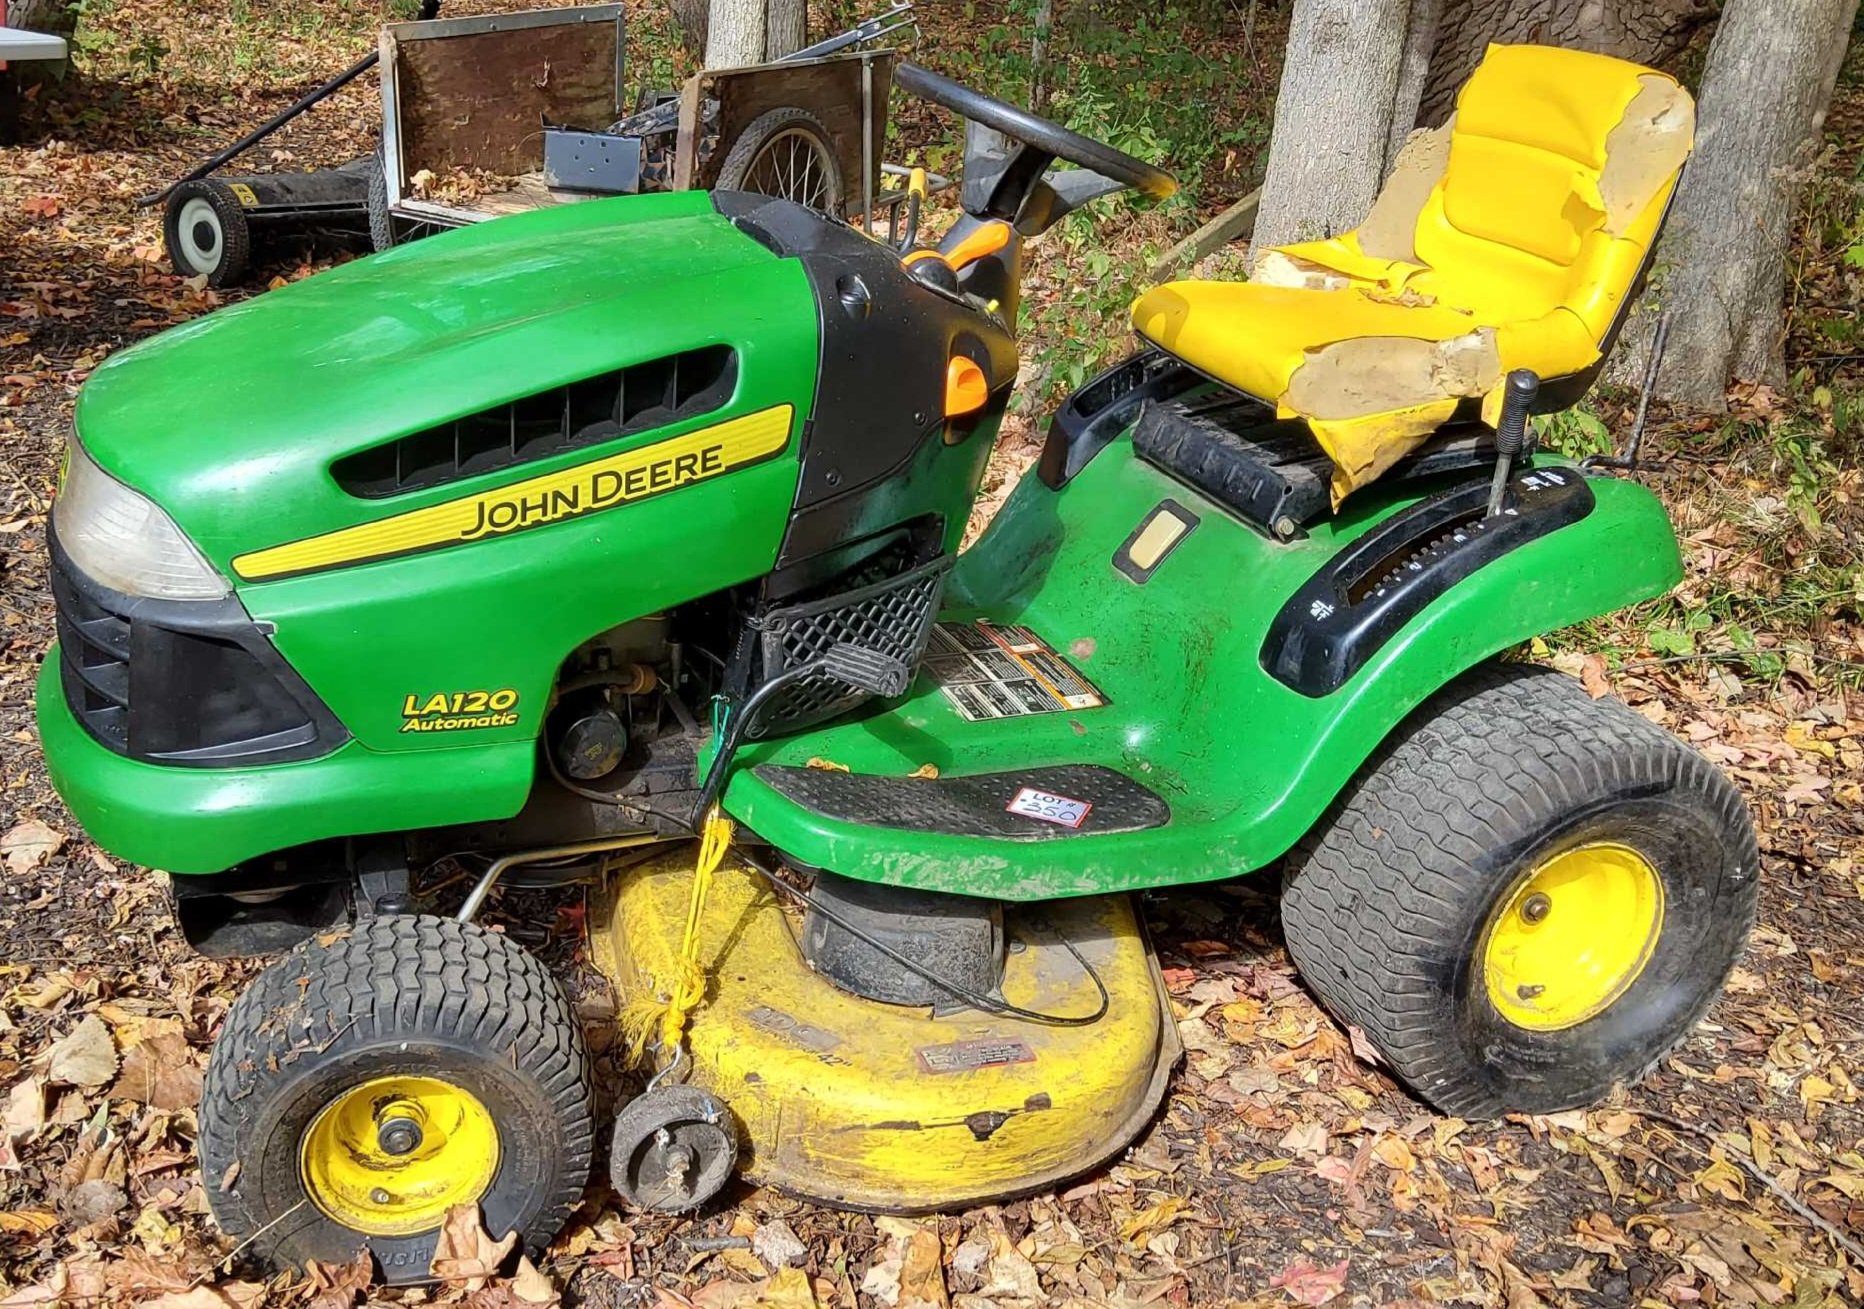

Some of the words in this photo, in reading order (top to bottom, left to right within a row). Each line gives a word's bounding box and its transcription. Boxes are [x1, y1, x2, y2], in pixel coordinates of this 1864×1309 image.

[460, 484, 579, 537] JOHN
[591, 444, 724, 505] DEERE
[403, 689, 518, 717] LA120
[401, 713, 519, 733] Automatic
[1033, 793, 1062, 805] LOT
[1022, 801, 1077, 820] 350
